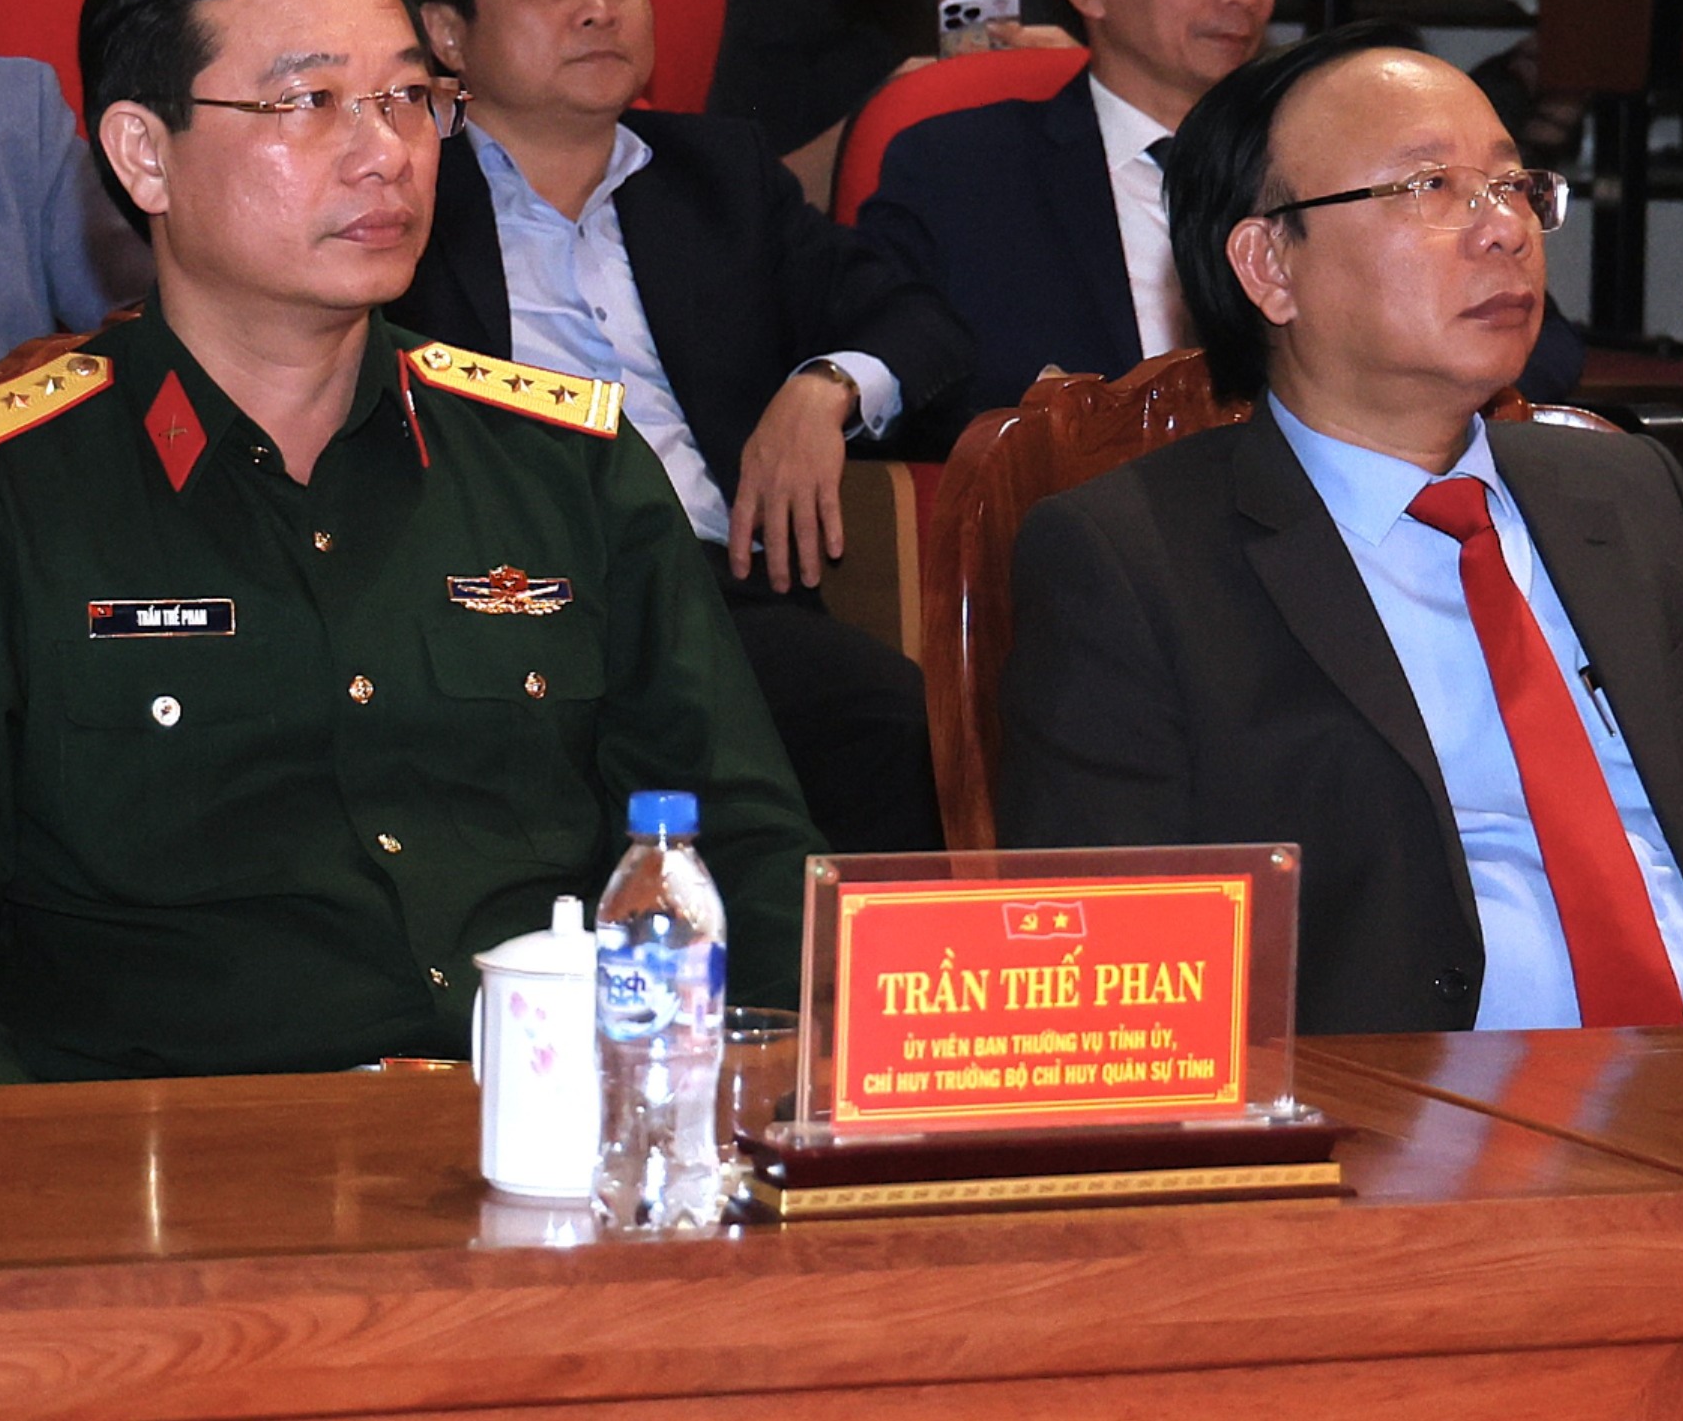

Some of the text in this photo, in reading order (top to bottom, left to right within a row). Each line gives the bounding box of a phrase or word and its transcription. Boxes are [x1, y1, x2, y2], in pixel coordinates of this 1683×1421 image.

[878, 945, 1206, 1015] TRẦN THẾ PHAN
[931, 1032, 971, 1059] VIÊN
[974, 1035, 1009, 1058] BAN
[1081, 1030, 1104, 1055] VỤ
[1107, 1023, 1147, 1051] TỈNH
[863, 1066, 893, 1094] CHỈ
[896, 1070, 931, 1093] HUY
[1005, 1060, 1029, 1090] BỘ
[1032, 1057, 1062, 1085] CHỈ
[1065, 1063, 1098, 1085] HUY
[1101, 1057, 1147, 1086] QUÂN
[1176, 1052, 1215, 1079] TỈNH
